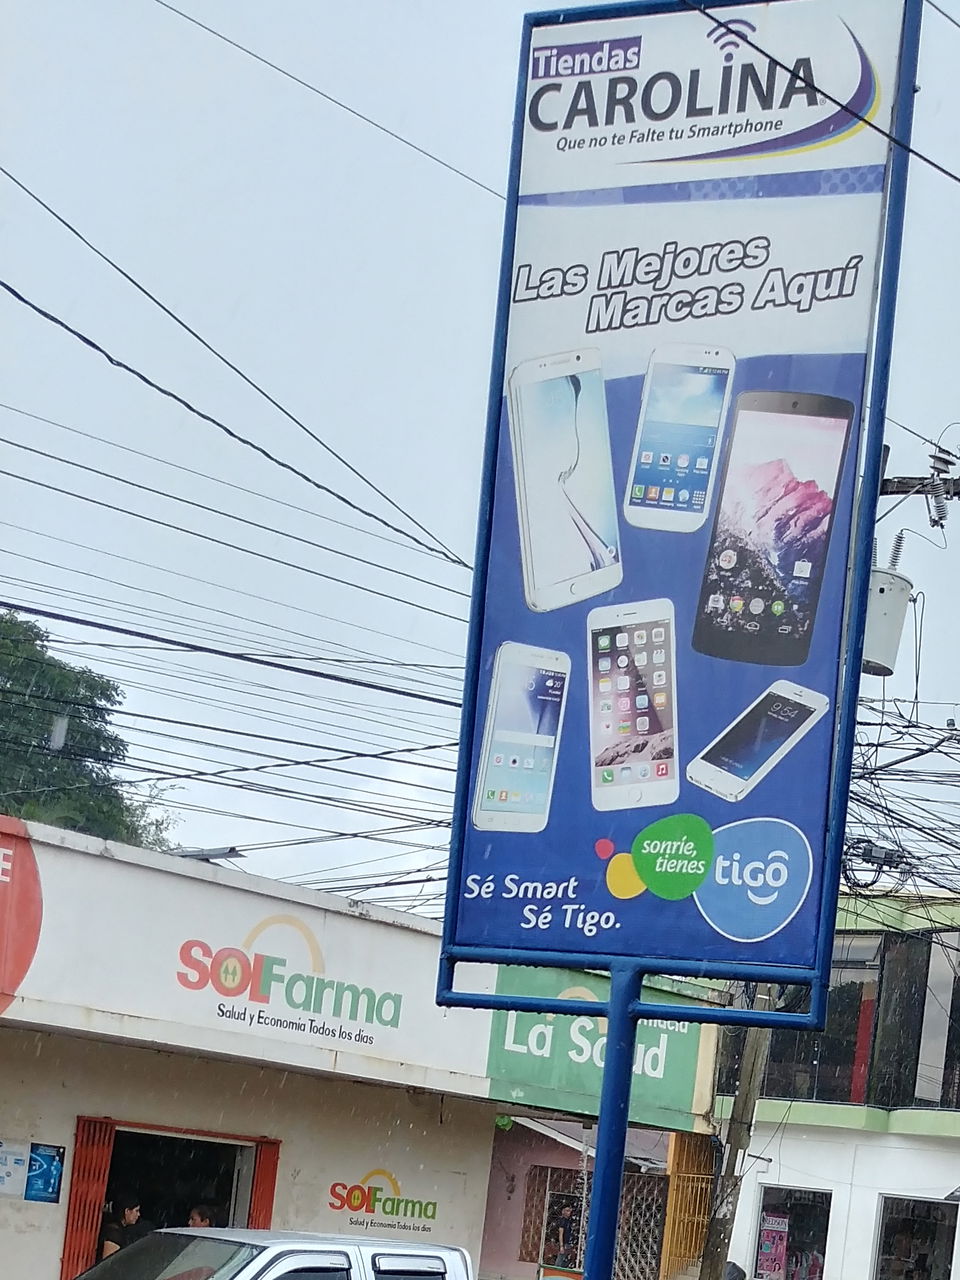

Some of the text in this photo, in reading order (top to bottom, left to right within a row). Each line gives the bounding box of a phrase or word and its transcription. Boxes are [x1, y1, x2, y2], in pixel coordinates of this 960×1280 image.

[533, 44, 641, 77] Tiendas
[528, 53, 820, 132] CAROLINA
[556, 118, 783, 152] Que no te Falte tu Smartphone
[513, 236, 770, 303] Las Mejores
[585, 255, 863, 333] Marcas Aquí
[641, 835, 698, 858] sonríe,
[655, 855, 705, 874] tienes
[463, 874, 579, 899] Sé Smart
[520, 904, 621, 937] Sé Tigo.
[217, 1003, 247, 1022] Salud
[249, 1012, 255, 1027] y
[308, 1018, 336, 1038] Todos
[338, 1025, 352, 1041] los
[504, 1010, 554, 1058] La
[349, 1217, 365, 1227] Salud
[365, 1220, 370, 1230] y
[397, 1221, 411, 1231] Todos
[412, 1223, 420, 1231] los
